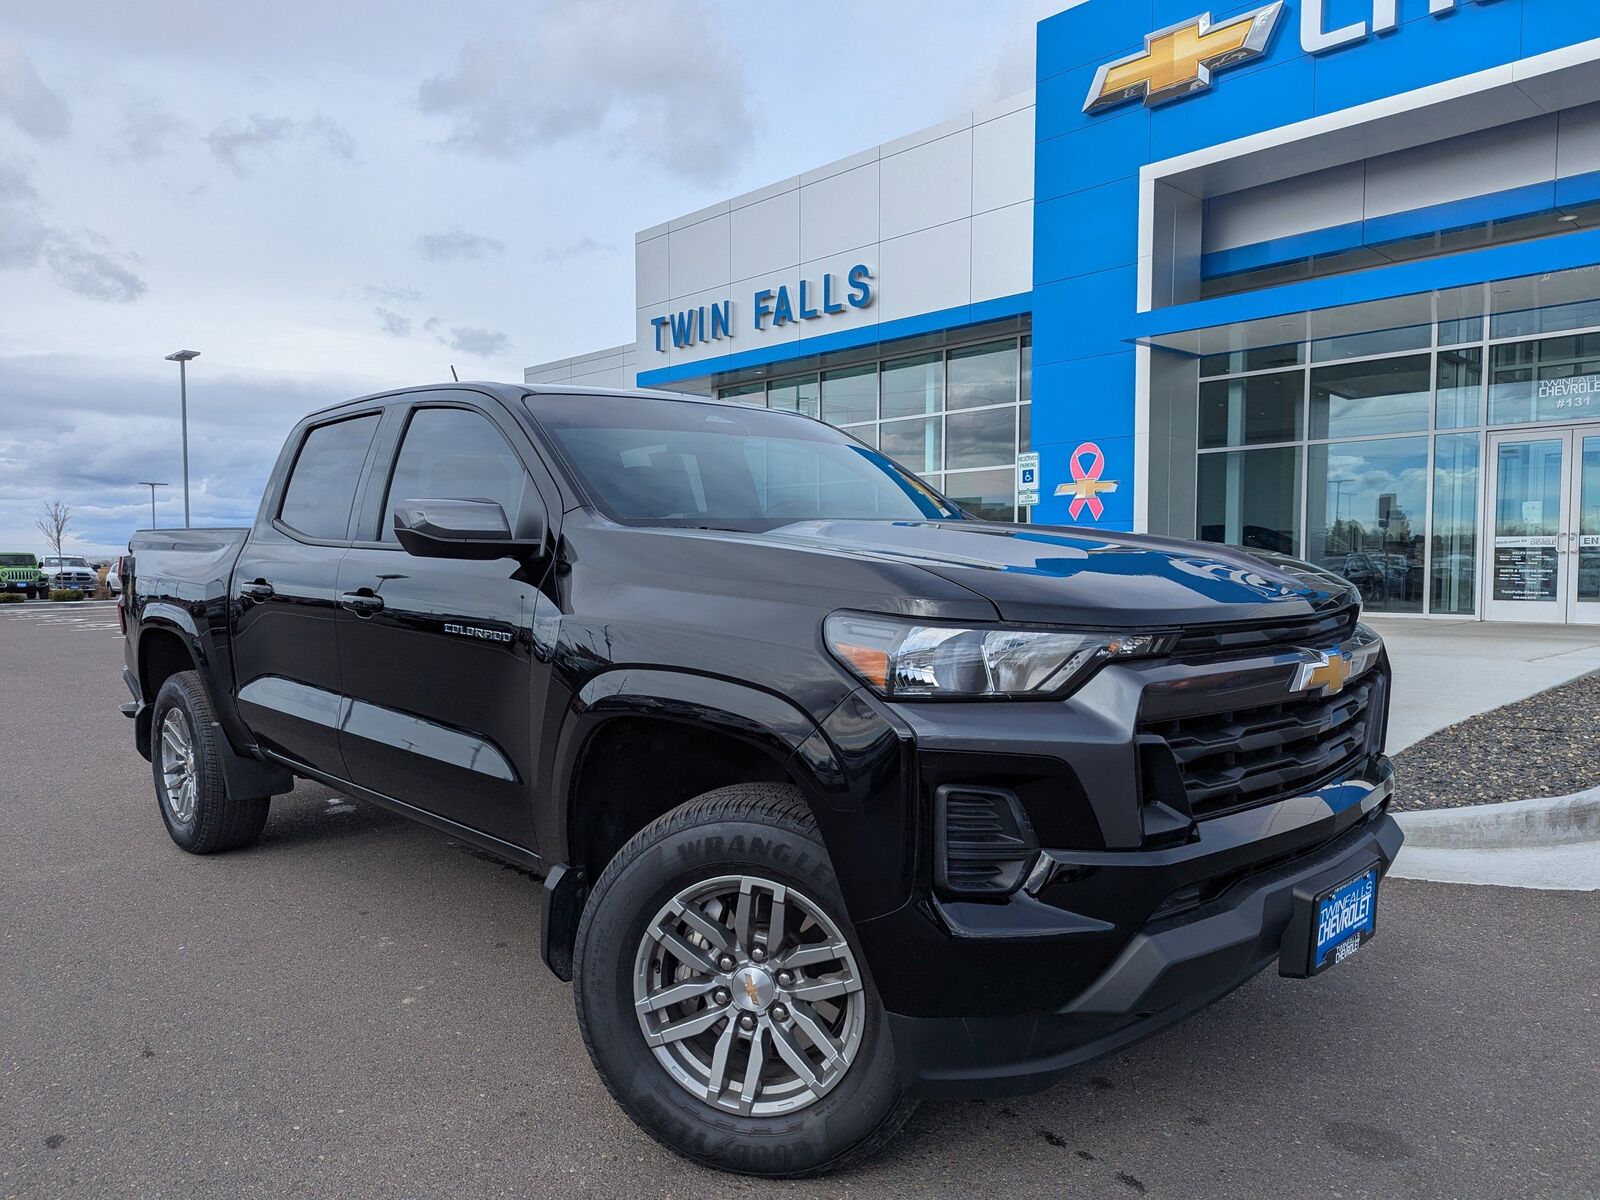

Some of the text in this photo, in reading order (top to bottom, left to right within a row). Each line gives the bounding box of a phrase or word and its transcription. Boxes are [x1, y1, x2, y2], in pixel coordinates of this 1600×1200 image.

[650, 264, 873, 352] TWIN FALLS
[1556, 396, 1591, 409] #131
[444, 623, 512, 642] COLORADO
[1320, 880, 1373, 923] TWINFALLS
[1317, 894, 1372, 947] CHEVROLET
[1335, 938, 1360, 964] CHEVROLET
